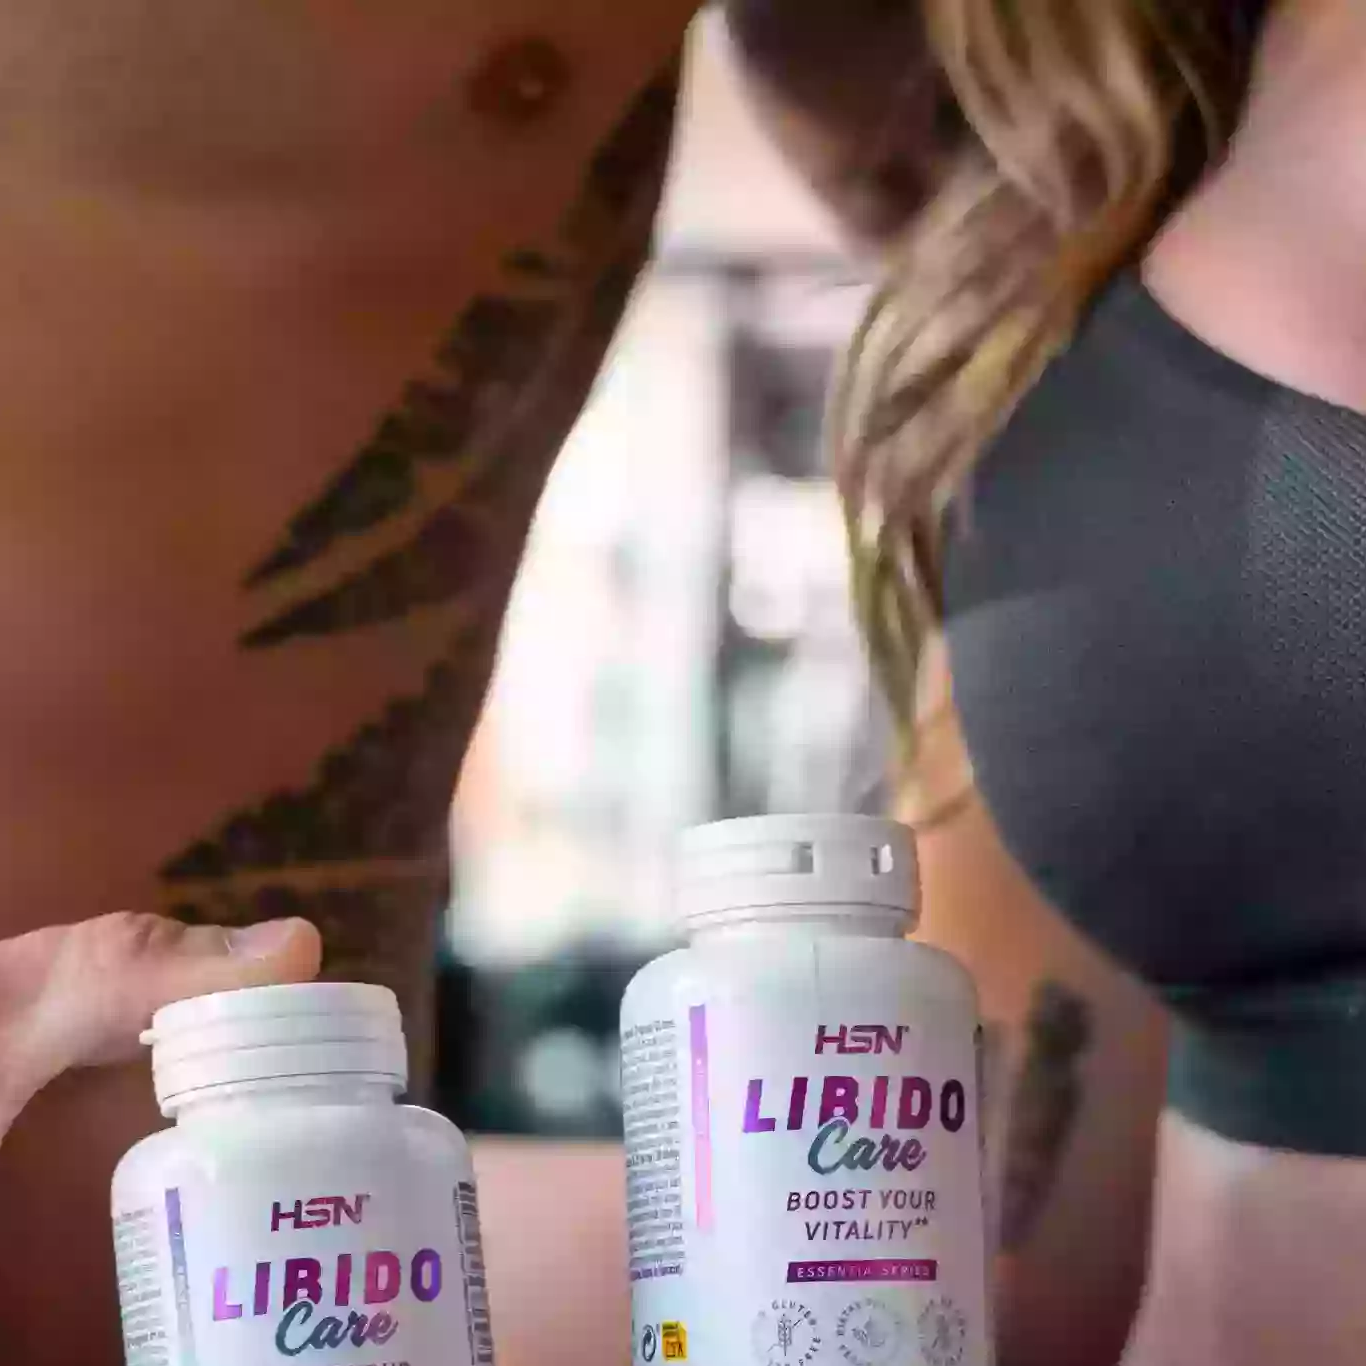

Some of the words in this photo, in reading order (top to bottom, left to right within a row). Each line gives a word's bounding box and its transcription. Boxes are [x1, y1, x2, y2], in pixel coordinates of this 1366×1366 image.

[815, 1024, 903, 1054] HSN
[743, 1076, 965, 1133] LIBIDO
[808, 1117, 927, 1176] Care
[271, 1193, 364, 1232] HSN
[787, 1190, 872, 1211] BOOST
[880, 1190, 936, 1211] YOUR
[213, 1248, 442, 1321] LIBIDO
[797, 1265, 878, 1279] ESSENTIA
[275, 1300, 399, 1357] Care
